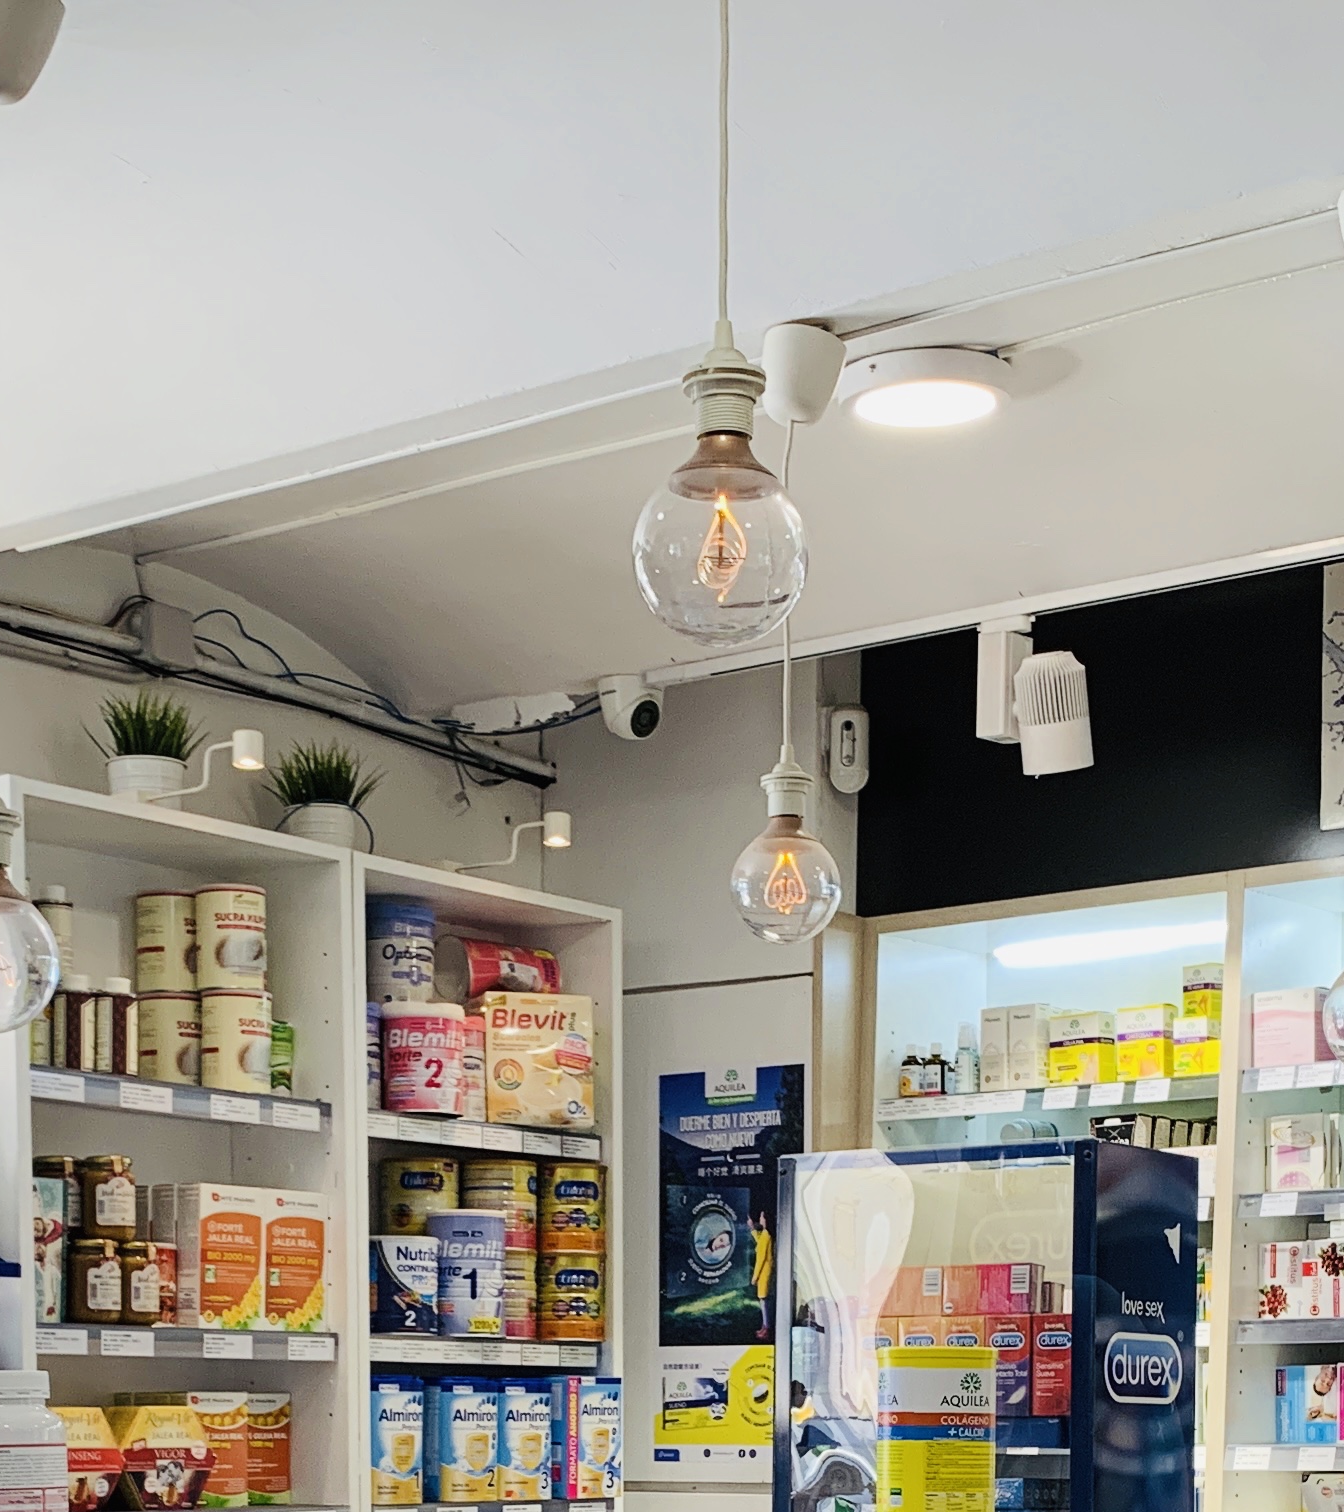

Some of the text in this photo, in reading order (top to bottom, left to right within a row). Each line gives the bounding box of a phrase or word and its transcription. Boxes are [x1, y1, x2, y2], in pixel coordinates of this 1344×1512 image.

[492, 1008, 567, 1031] Blevit
[424, 1058, 445, 1089] 2
[714, 1083, 746, 1093] AQUILEA
[206, 1233, 255, 1246] JALEA REAL
[1121, 1291, 1166, 1325] love sex
[993, 1333, 1024, 1348] durex
[1039, 1333, 1071, 1349] durex
[1113, 1351, 1176, 1391] durex
[941, 1395, 990, 1408] AQUILEA
[506, 1409, 551, 1423] Almirón
[581, 1403, 619, 1416] Almirón
[941, 1412, 990, 1426] COLÁGENO
[959, 1427, 985, 1438] CALCIO
[487, 1469, 496, 1488] 2
[541, 1471, 549, 1490] 3
[606, 1470, 615, 1489] 3
